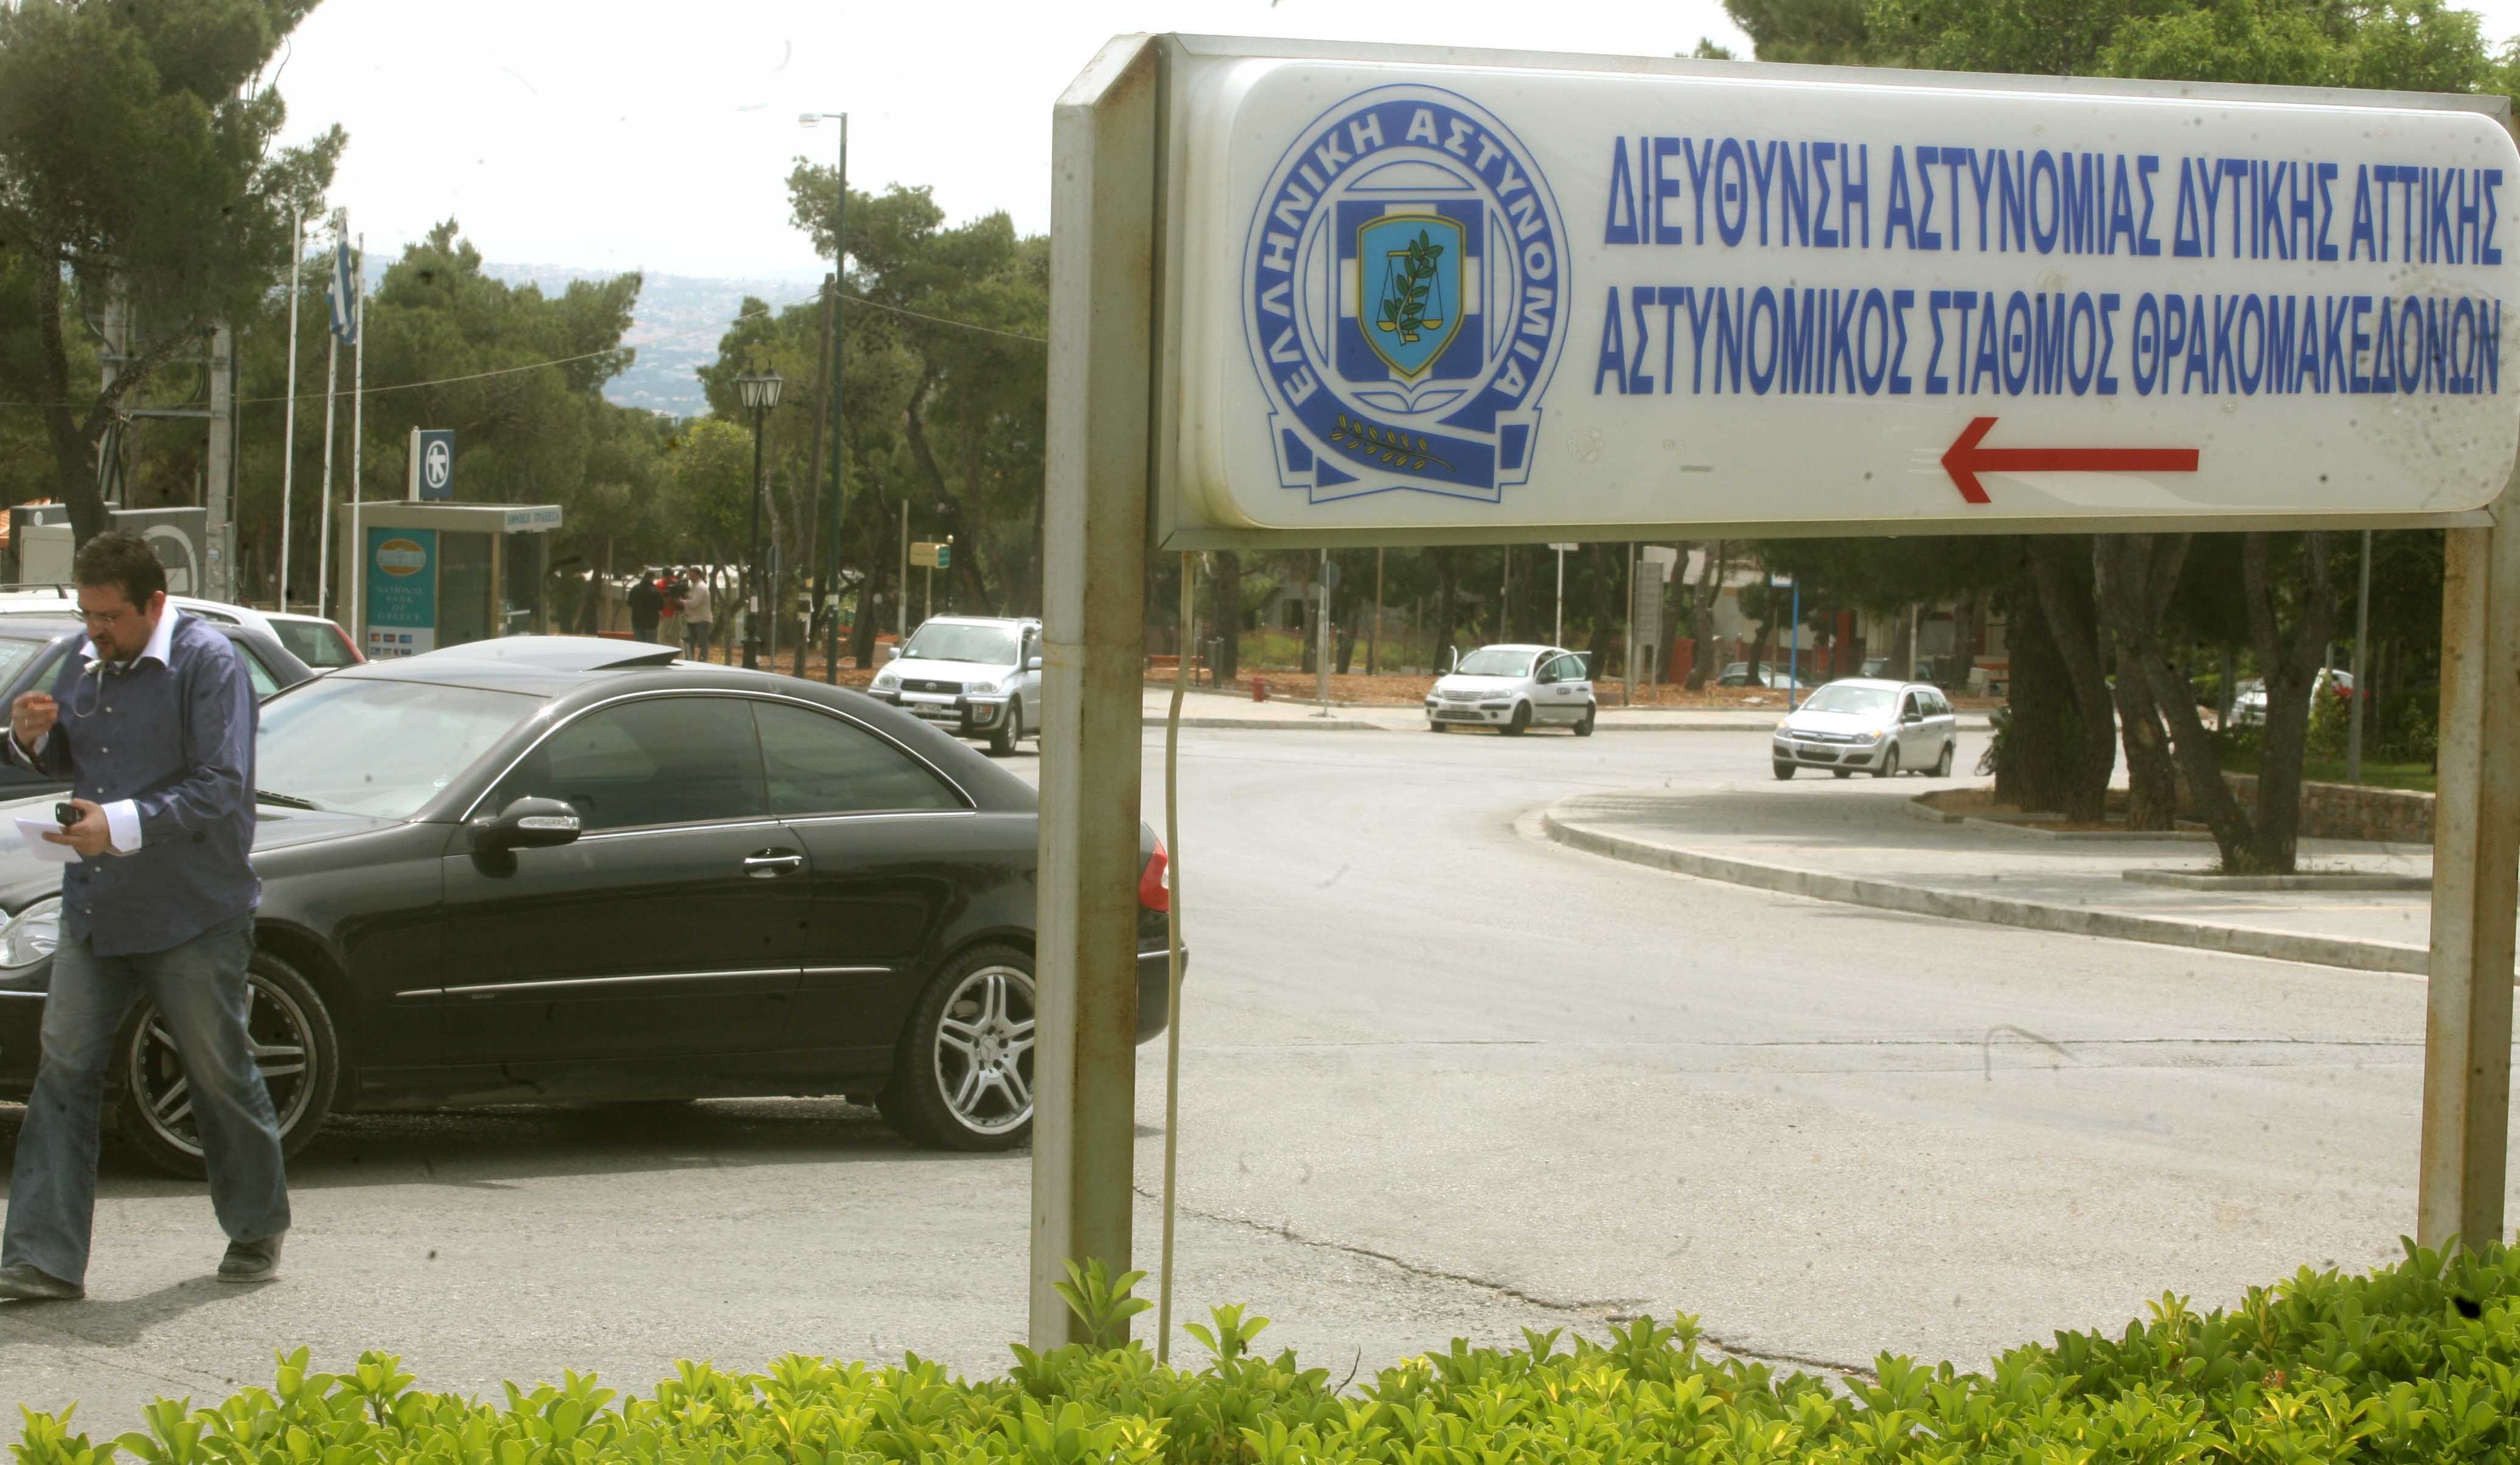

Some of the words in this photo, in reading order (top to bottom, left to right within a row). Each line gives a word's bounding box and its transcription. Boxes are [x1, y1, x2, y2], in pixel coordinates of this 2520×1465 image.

[1261, 112, 1385, 408] ΕΛΛΗΝΙΚΗ
[1405, 108, 1553, 399] ΑΣΤΥΝΟΜΙΑ
[1604, 135, 1870, 248] ΔΙΕΥΘΥΝΣΗ
[1884, 144, 2162, 256] ΑΣΤΥΝΟΜΙΑΣ
[2173, 156, 2339, 262] ΔΥΤΙΚΗΣ
[2348, 164, 2504, 265] ΑΤΤΙΚΗΣ
[1594, 285, 1915, 395] ΑΣΤΥΝΟΜΙΚΟΣ
[1926, 290, 2121, 396] ΣΤΑΘΜΟΣ
[2132, 291, 2501, 396] ΘΡΑΚΟΜΑΚΕΔΟΝΩΝ
